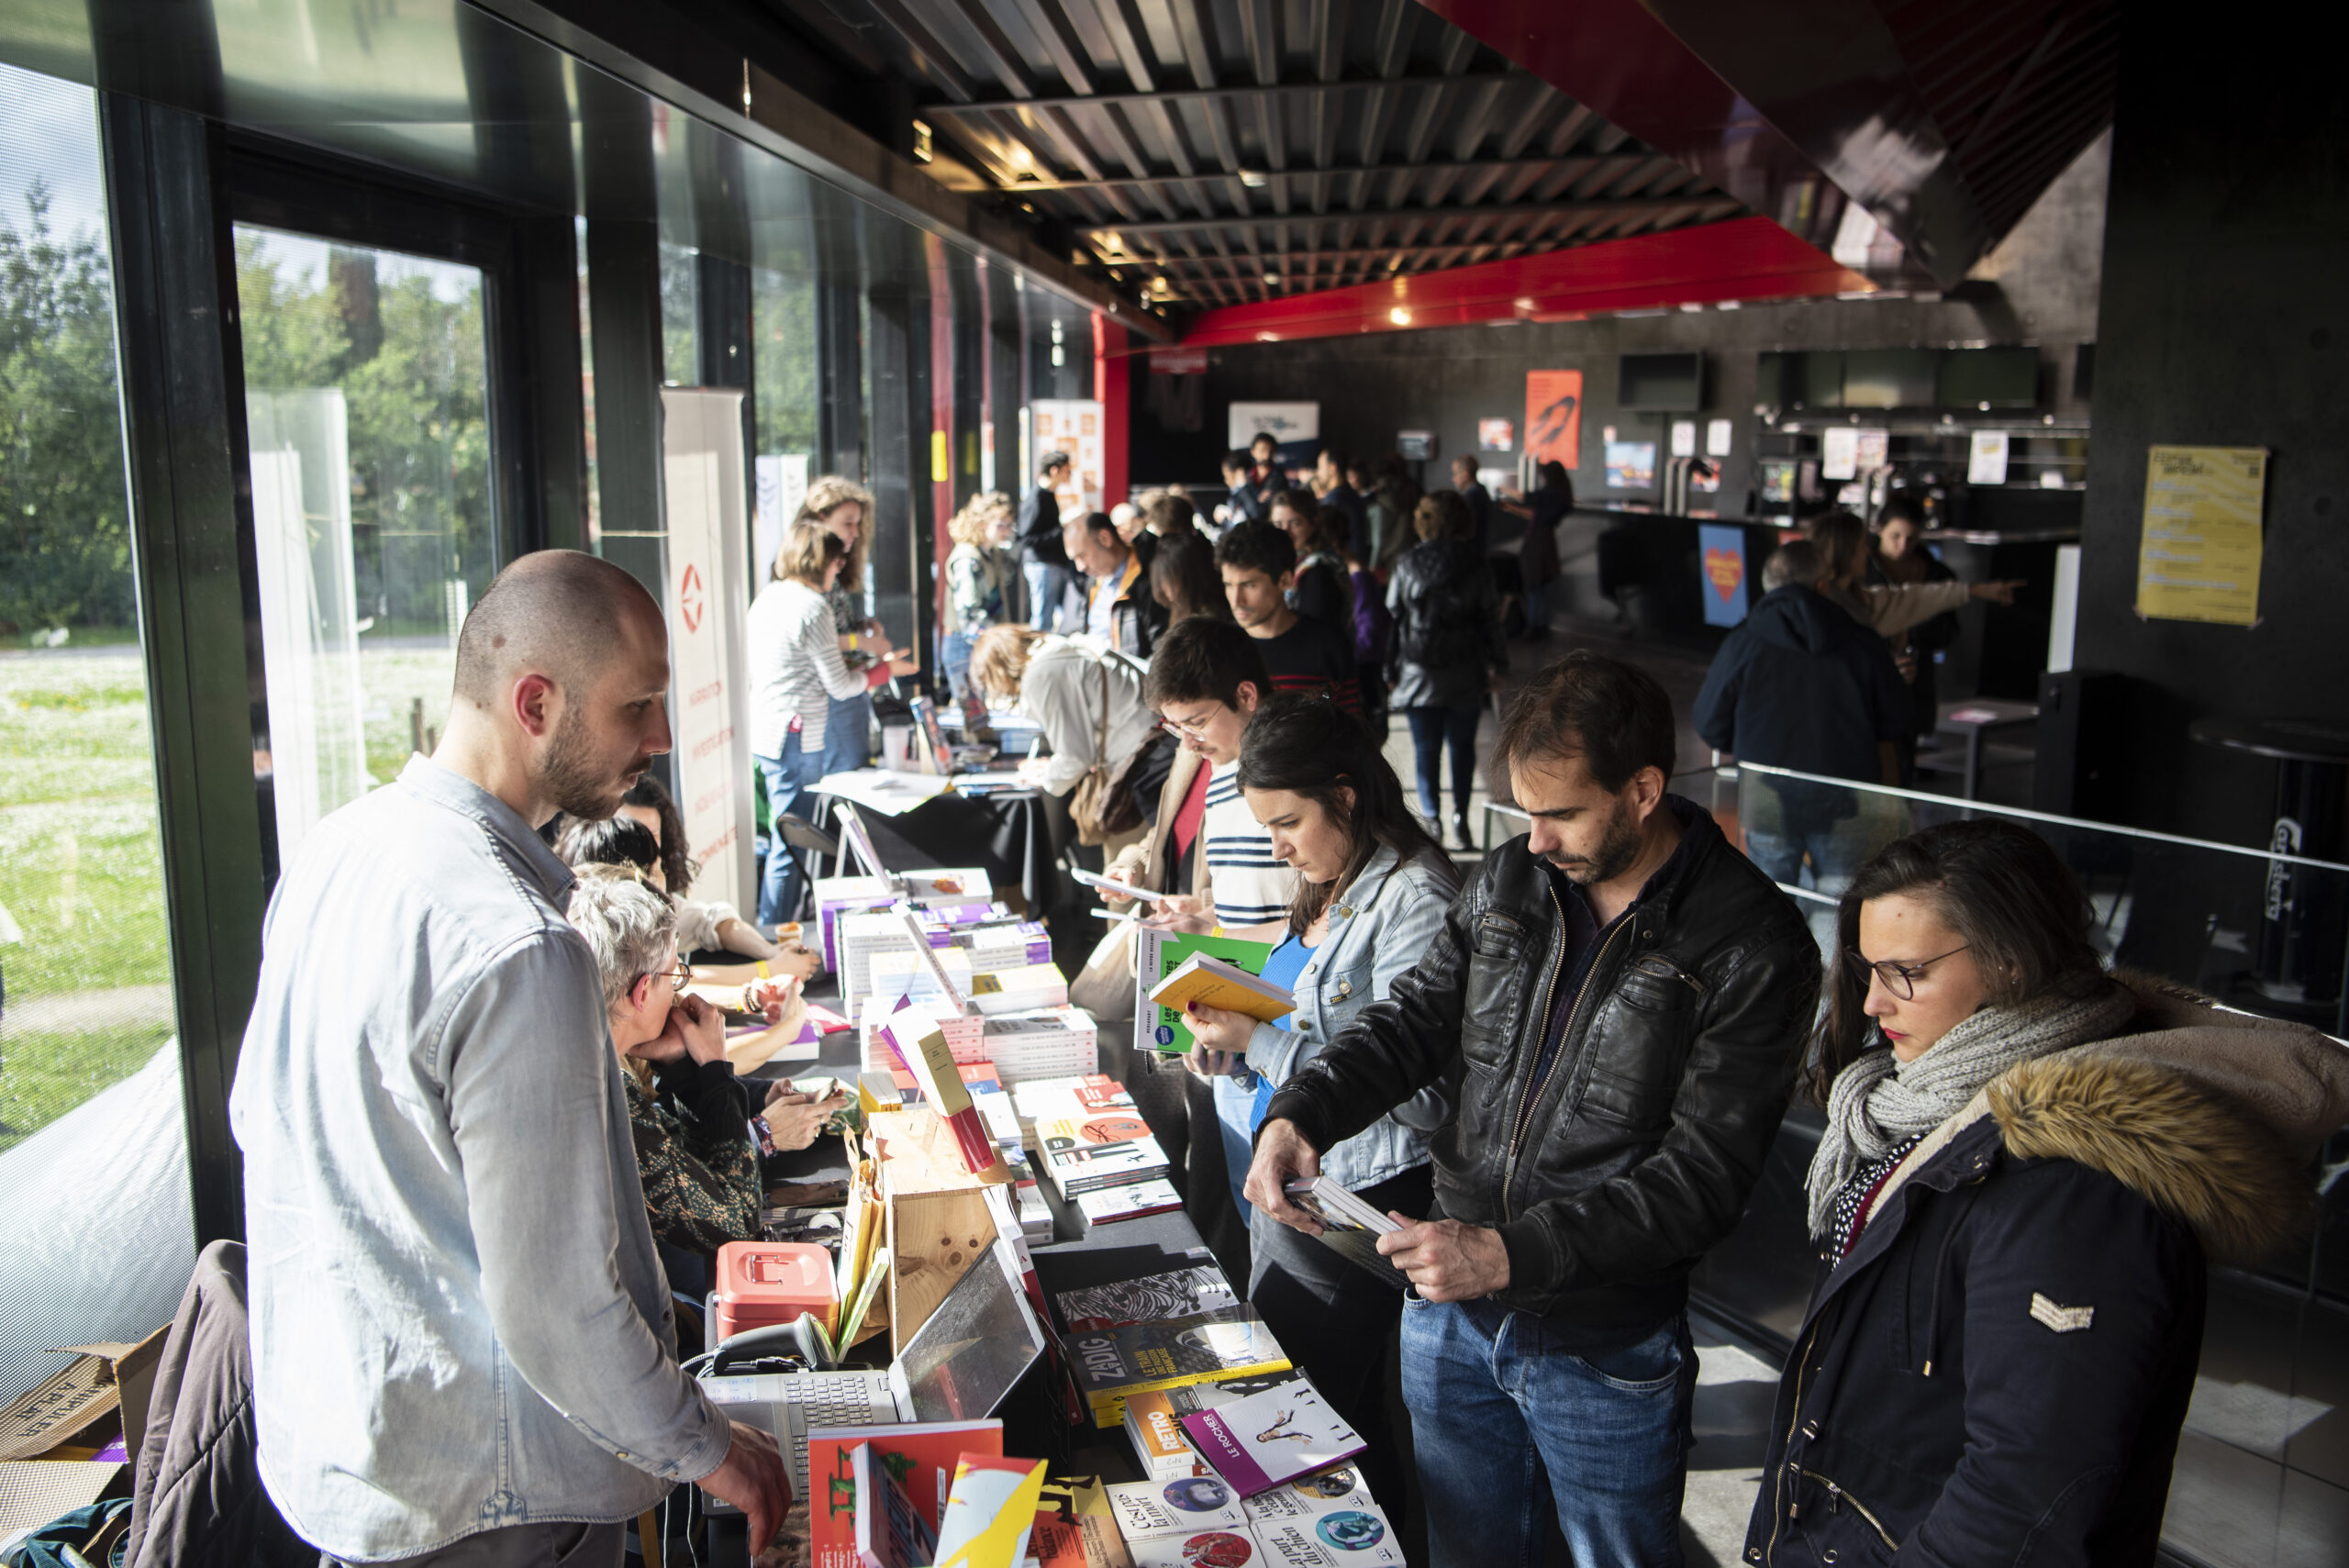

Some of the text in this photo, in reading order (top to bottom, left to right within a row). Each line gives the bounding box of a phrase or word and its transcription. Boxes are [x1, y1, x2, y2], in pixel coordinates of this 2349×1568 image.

[1078, 1338, 1125, 1383] ZADIG
[1133, 1350, 1157, 1377] LE TRAIN
[1148, 1411, 1181, 1451] RETRO
[1202, 1414, 1231, 1448] ROCHER
[1227, 1447, 1241, 1458] LE
[1114, 1494, 1141, 1508] pas
[1135, 1496, 1170, 1529] la mort
[1270, 1537, 1302, 1558] part
[1282, 1527, 1323, 1565] du chien
